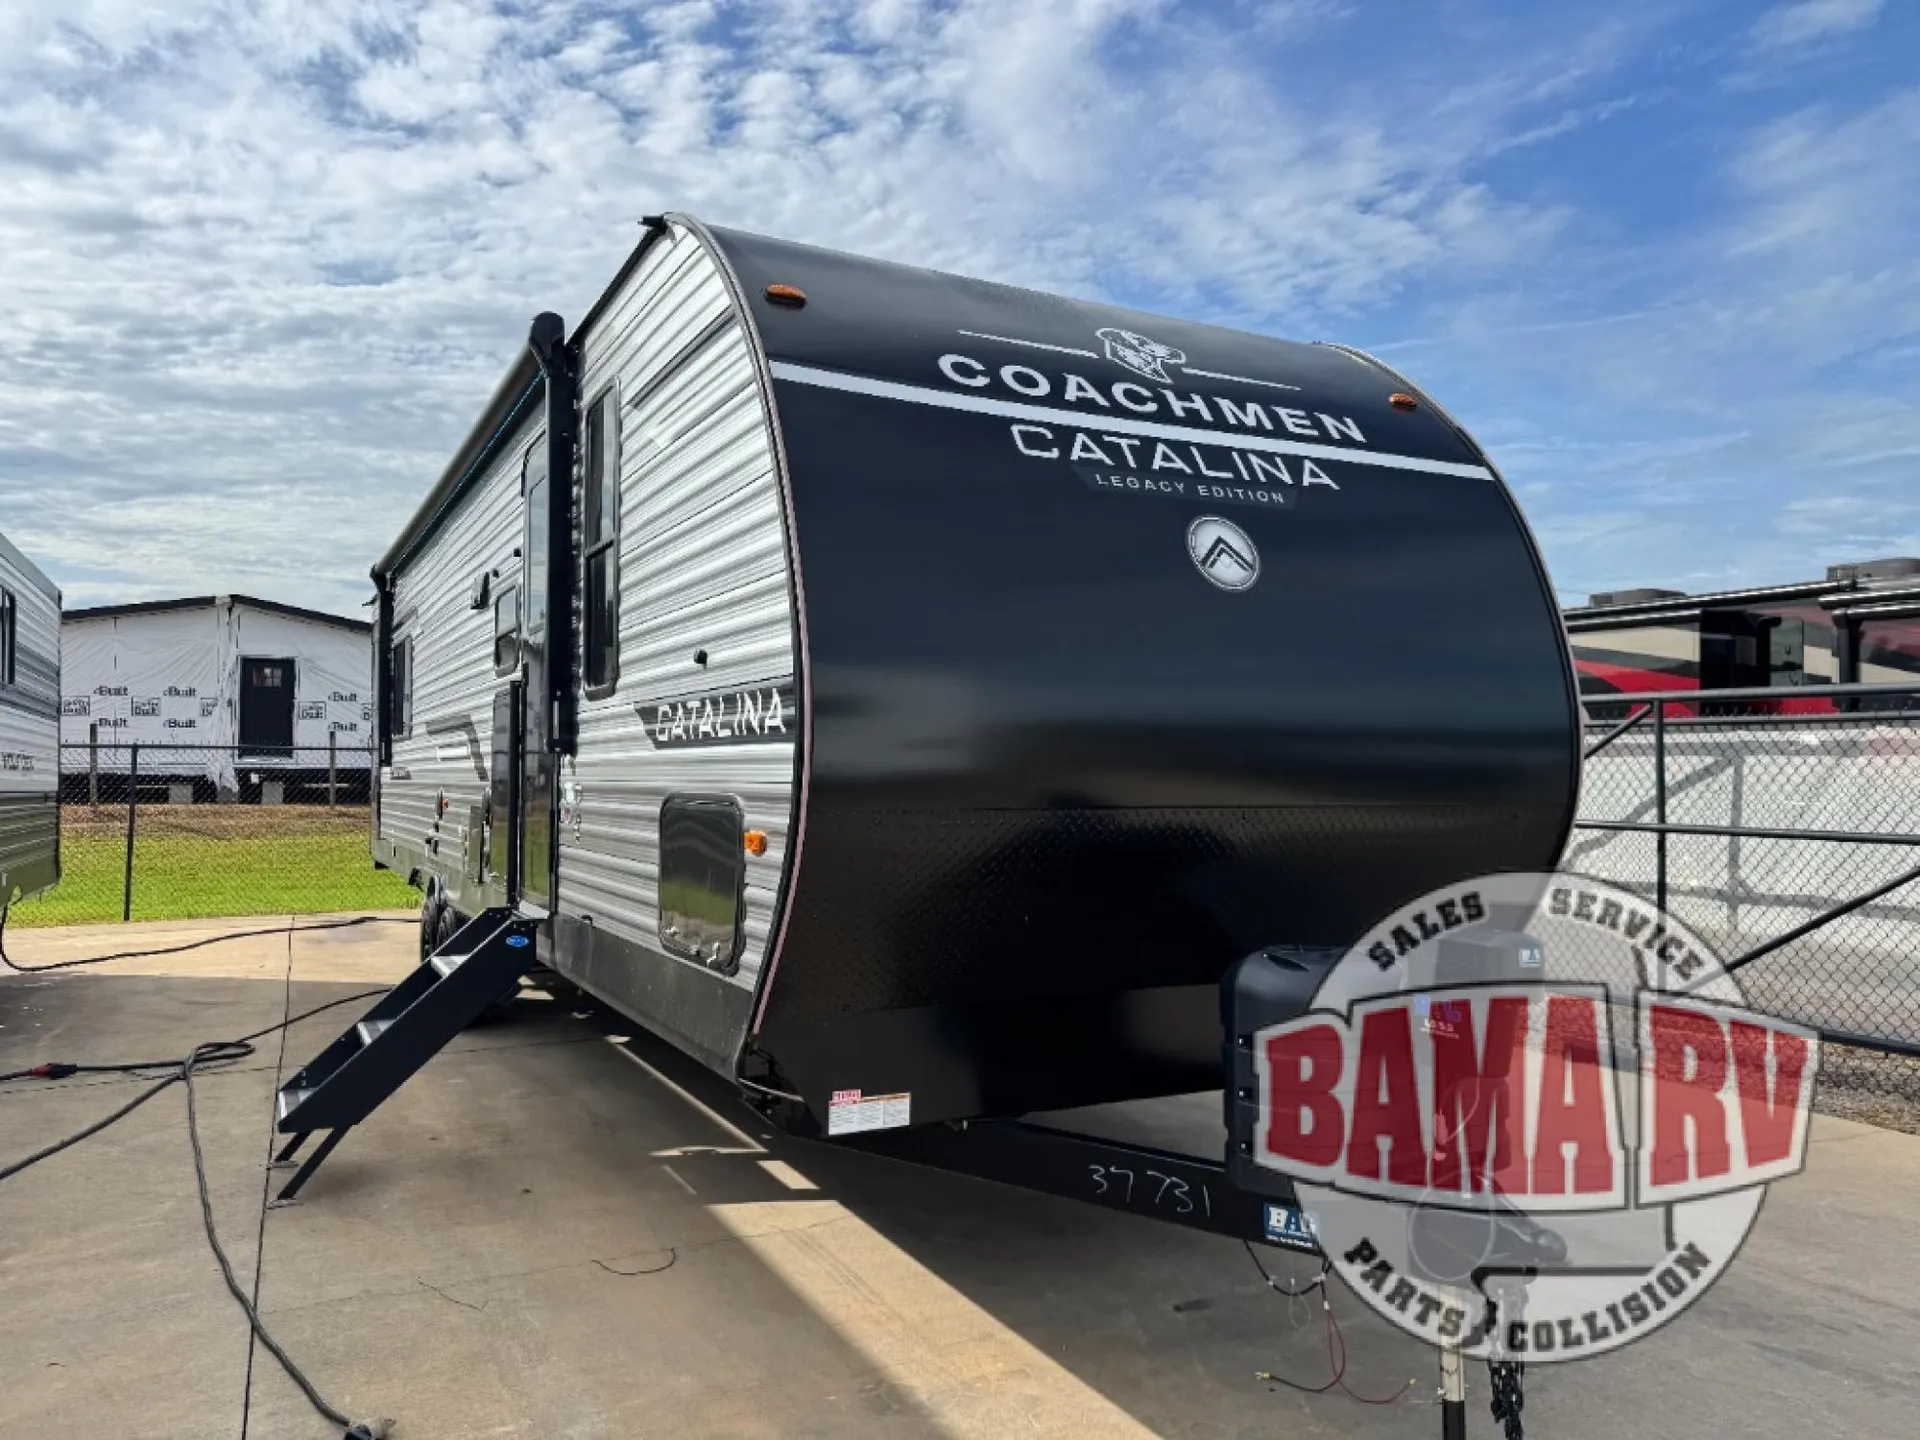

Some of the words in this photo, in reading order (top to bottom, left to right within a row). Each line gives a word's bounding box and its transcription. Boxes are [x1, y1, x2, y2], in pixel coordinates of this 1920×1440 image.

[938, 354, 1367, 443] COACHMEN
[1010, 424, 1340, 490] CATALINA
[1096, 473, 1185, 495] LEGACY
[1198, 484, 1286, 504] EDITION
[657, 687, 786, 741] CATALINA
